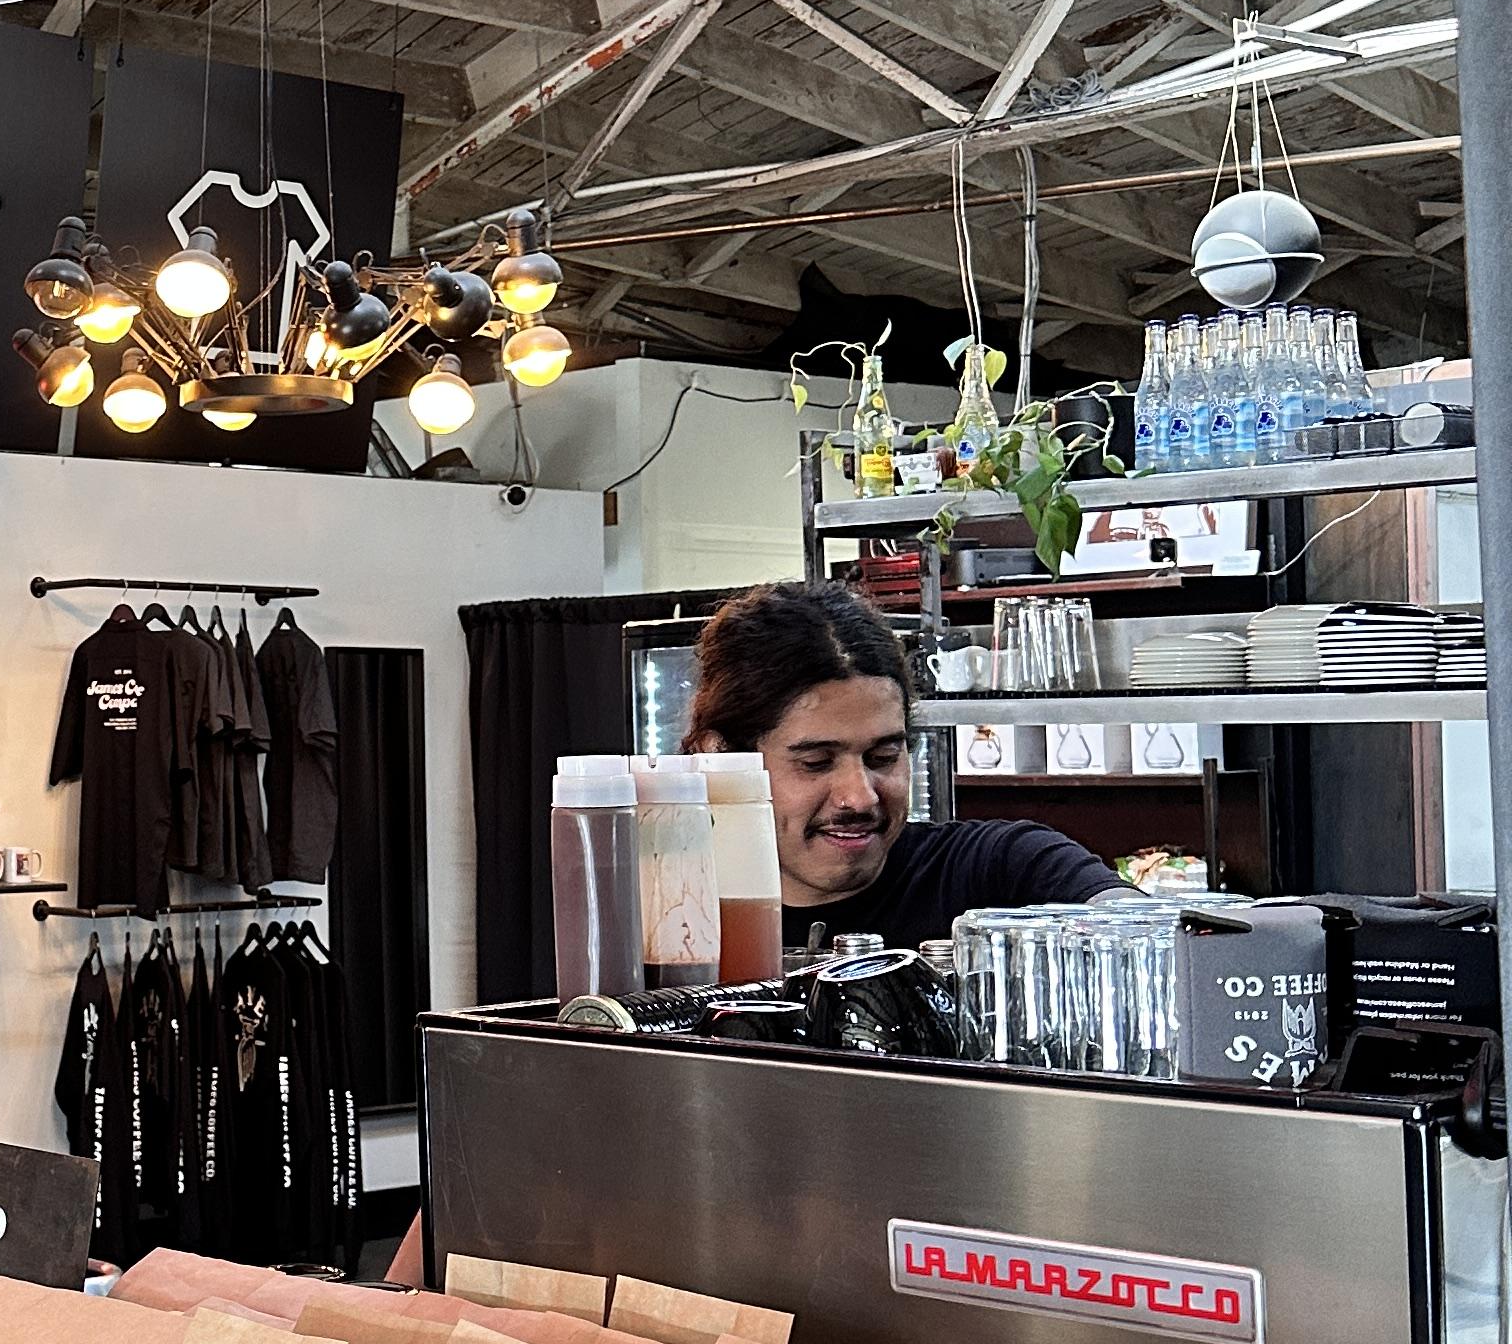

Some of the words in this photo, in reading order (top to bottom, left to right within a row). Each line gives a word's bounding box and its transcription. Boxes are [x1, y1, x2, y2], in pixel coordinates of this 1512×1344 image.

[1216, 976, 1265, 998] CO.
[1272, 972, 1327, 996] OFFEE
[966, 1252, 1240, 1325] MARZOCCO
